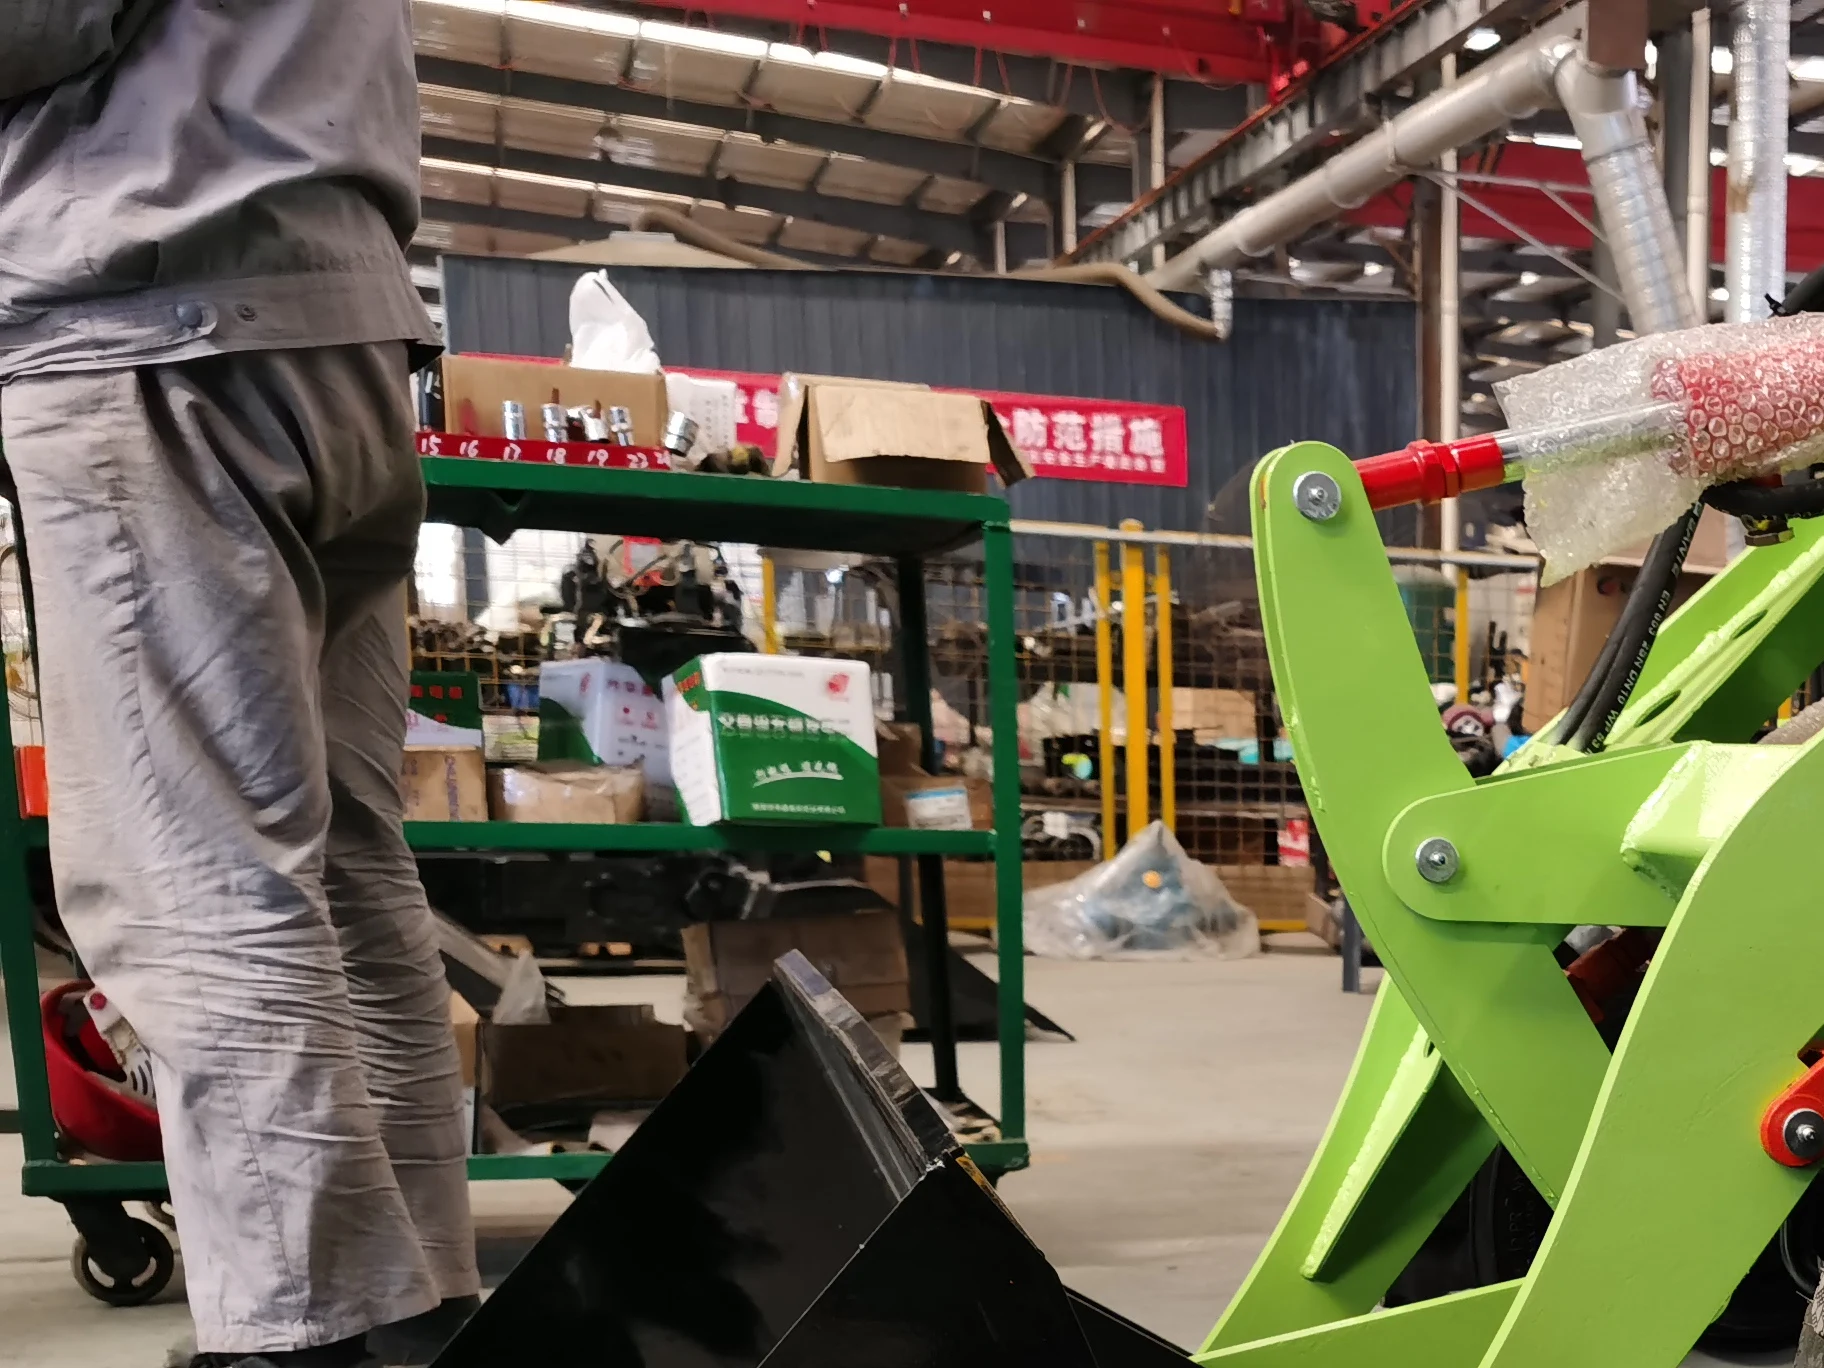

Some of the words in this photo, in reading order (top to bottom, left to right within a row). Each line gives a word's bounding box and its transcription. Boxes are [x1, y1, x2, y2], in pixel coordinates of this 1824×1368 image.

[421, 433, 442, 456] 15
[459, 439, 480, 458] 16
[547, 446, 567, 465] 18
[587, 448, 609, 467] 19
[997, 407, 1165, 457] 防范措施
